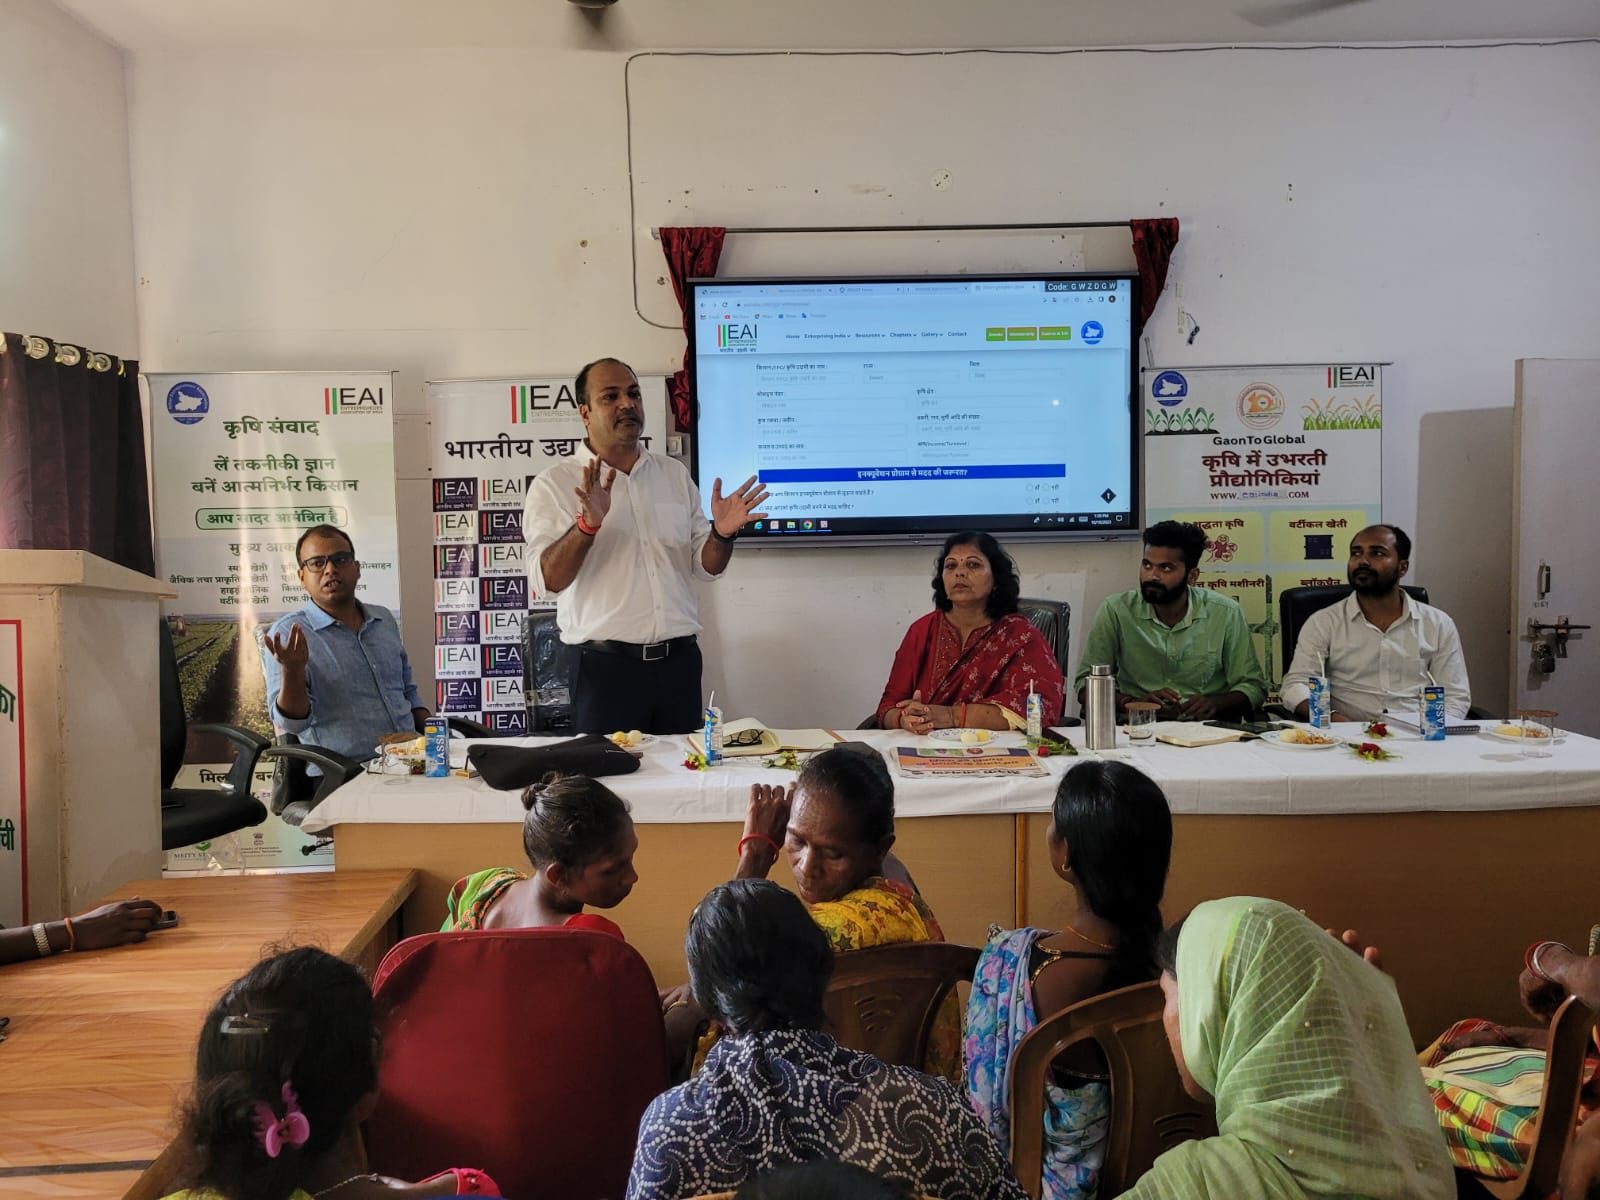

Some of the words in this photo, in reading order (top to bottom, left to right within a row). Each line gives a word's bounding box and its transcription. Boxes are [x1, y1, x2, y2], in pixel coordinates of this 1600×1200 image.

[1047, 283, 1069, 291] Code:
[530, 384, 578, 410] EA
[222, 415, 263, 439] कृषि
[267, 416, 320, 436] संवाद
[444, 432, 534, 460] भारतीय
[539, 438, 582, 457] उद्य
[213, 455, 229, 471] लें
[233, 454, 301, 471] तकनीकी
[304, 458, 336, 473] ज्ञान
[1201, 450, 1241, 472] कृषि
[1245, 449, 1262, 467] में
[1266, 448, 1328, 467] उभरती
[191, 477, 217, 493] बनें
[222, 476, 302, 493] आत्मनिर्भर
[306, 475, 359, 492] किसान
[1209, 468, 1321, 487] प्रौद्योगिकियां
[207, 514, 234, 524] आप
[1225, 518, 1245, 530] कृषि
[1325, 518, 1348, 528] खेती
[215, 575, 241, 585] प्राकृति
[1230, 578, 1265, 588] मशीनरी
[495, 647, 520, 661] EA
[496, 679, 521, 695] EA
[1435, 701, 1445, 730] LASSI
[435, 734, 446, 766] LASSI
